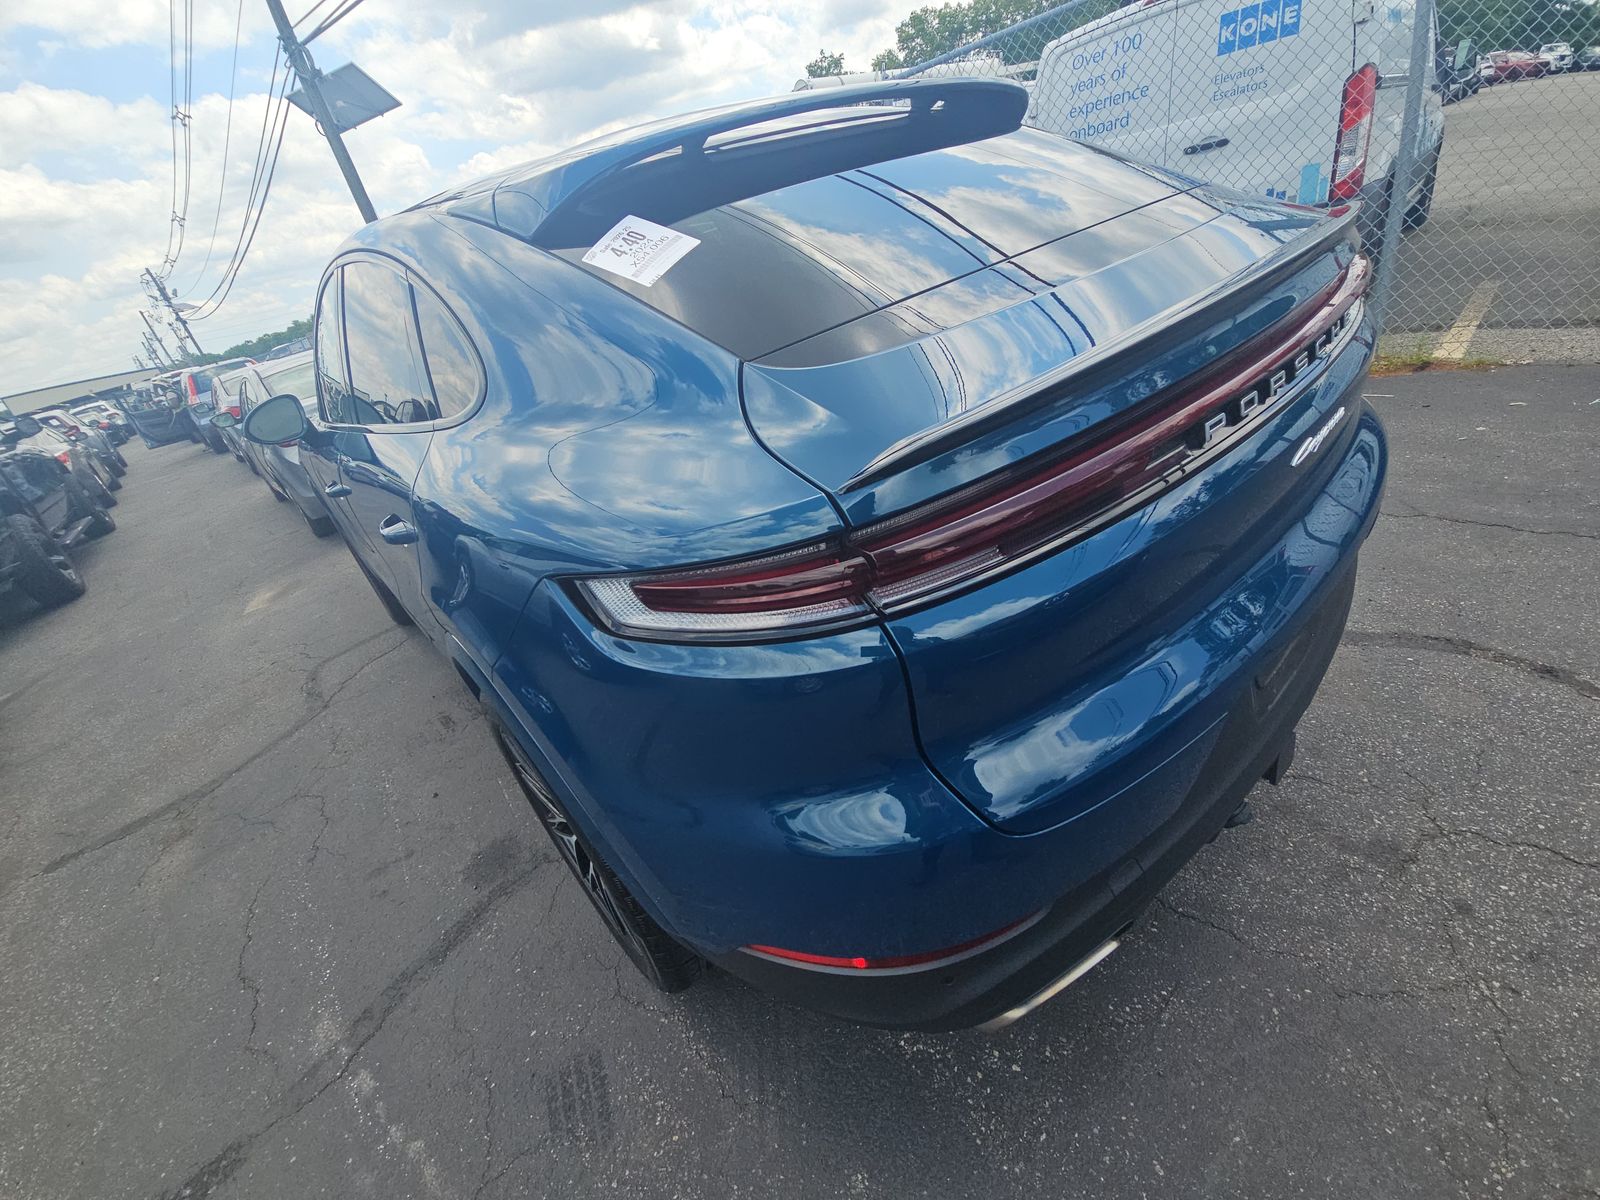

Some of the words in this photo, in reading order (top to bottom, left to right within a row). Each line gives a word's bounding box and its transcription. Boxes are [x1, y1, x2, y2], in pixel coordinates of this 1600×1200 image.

[1220, 5, 1299, 44] KONE
[1073, 48, 1107, 70] Over
[1114, 33, 1142, 57] 100
[1070, 74, 1106, 101] years
[1112, 61, 1127, 82] of
[1213, 80, 1268, 101] Escalators
[1214, 63, 1265, 85] Elevators
[1069, 85, 1149, 119] experience
[1069, 111, 1130, 139] onboard
[609, 230, 647, 259] 4:40
[1204, 309, 1352, 443] PORSCHE
